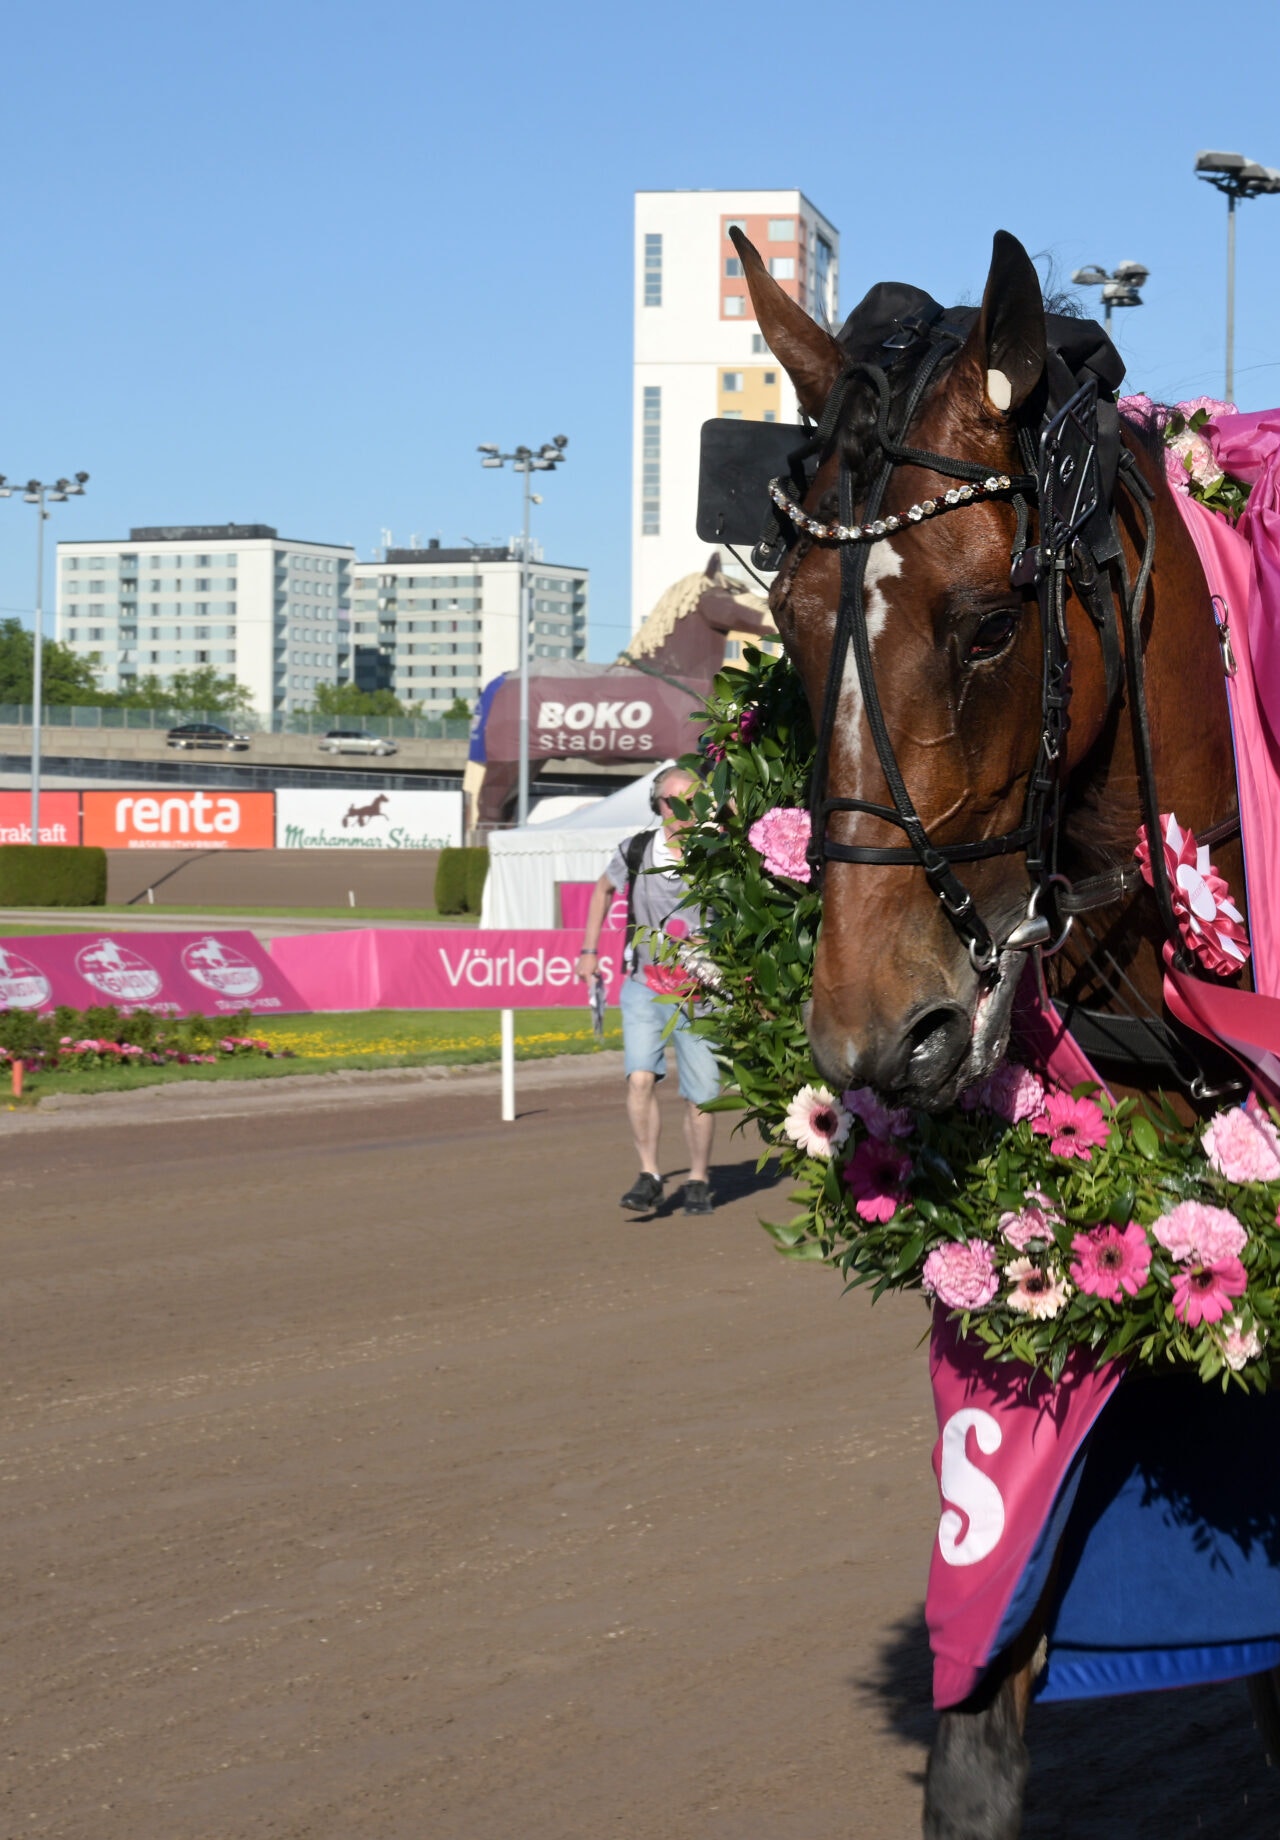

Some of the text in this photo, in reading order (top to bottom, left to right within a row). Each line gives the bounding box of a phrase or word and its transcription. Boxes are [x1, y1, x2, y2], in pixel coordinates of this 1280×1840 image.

[537, 701, 653, 730] BOKO
[539, 730, 653, 751] stables
[115, 791, 241, 833] renta
[438, 948, 614, 987] Världes
